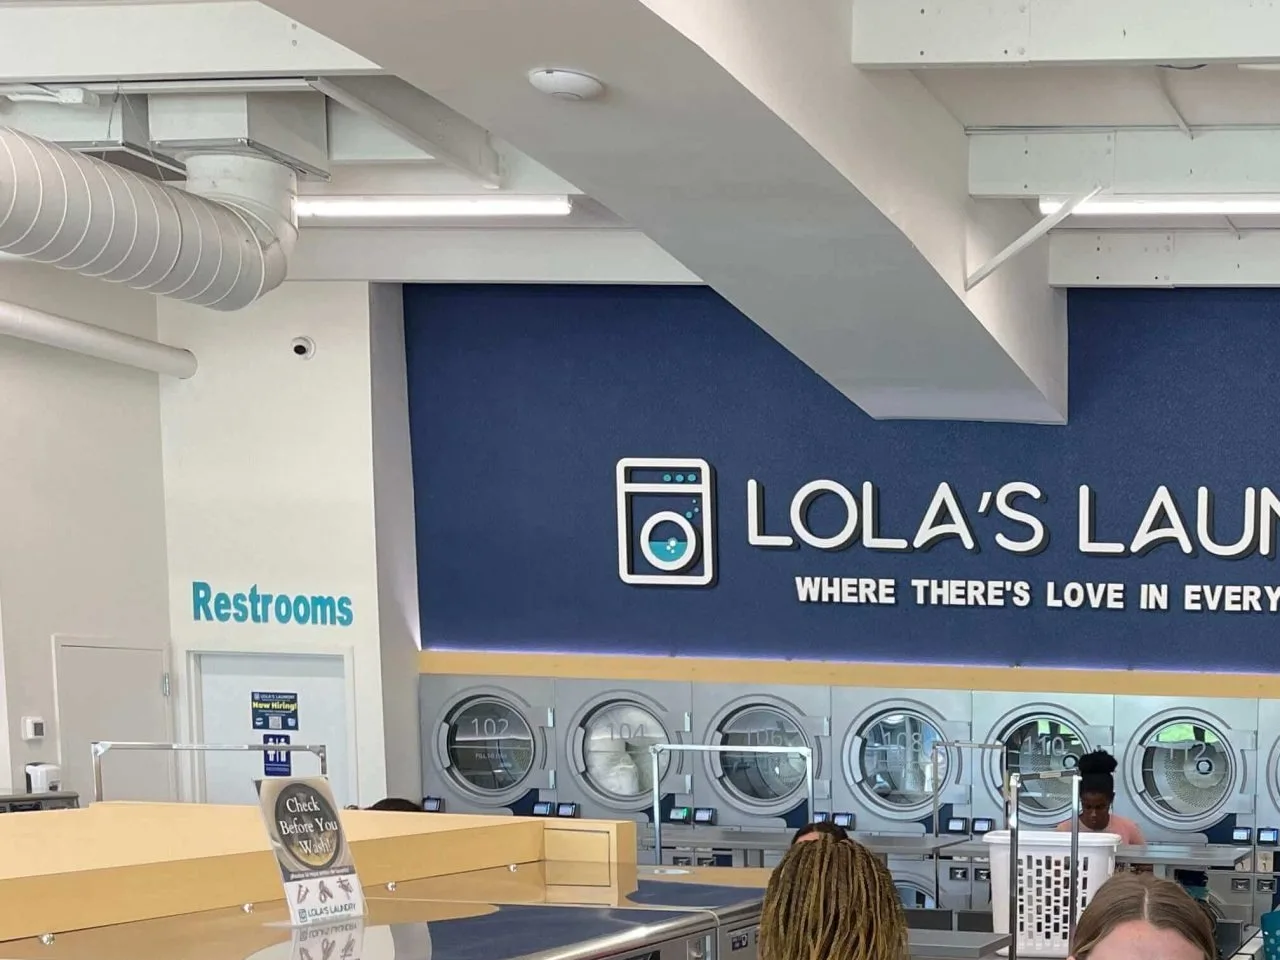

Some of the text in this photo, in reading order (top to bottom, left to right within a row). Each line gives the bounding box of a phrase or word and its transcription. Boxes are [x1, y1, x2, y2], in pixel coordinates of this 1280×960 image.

[747, 479, 1047, 553] LOLA'S
[796, 576, 896, 604] WHERE
[912, 579, 1030, 607] THERE'S
[1046, 582, 1124, 609] LOVE
[1140, 585, 1168, 611] IN
[192, 581, 354, 626] Restrooms
[471, 718, 510, 737] 102
[607, 721, 645, 742] 104
[747, 729, 783, 747] 106
[885, 732, 924, 752] 108
[1024, 735, 1065, 757] 110
[1170, 742, 1207, 761] 112
[286, 794, 320, 813] Check
[280, 817, 338, 836] Before You
[299, 838, 332, 855] Wash!
[308, 902, 357, 918] LOLA'S LAUNDRY
